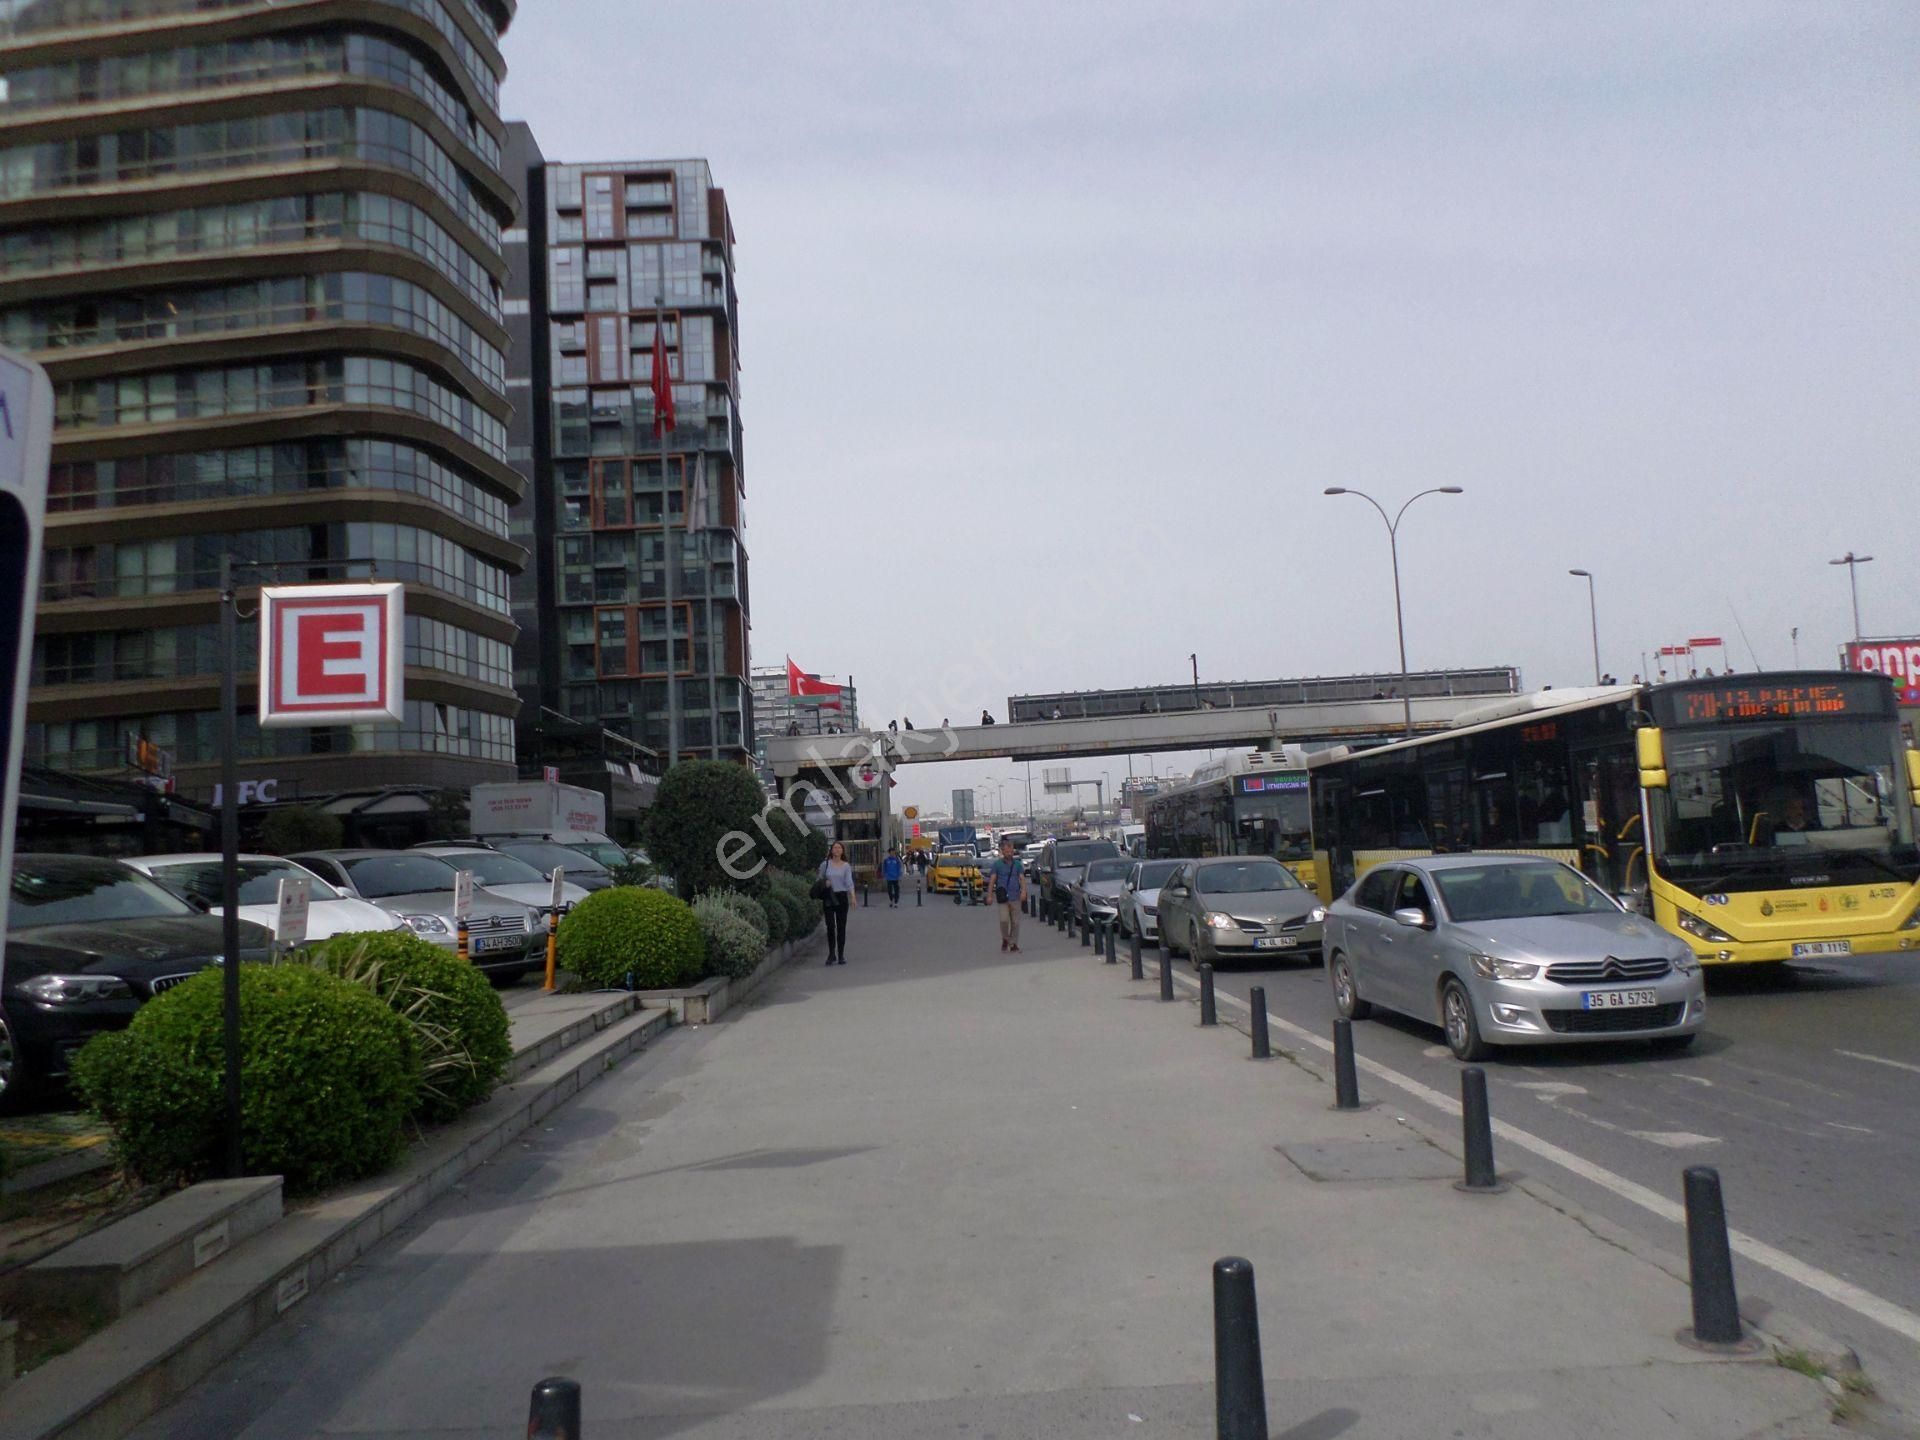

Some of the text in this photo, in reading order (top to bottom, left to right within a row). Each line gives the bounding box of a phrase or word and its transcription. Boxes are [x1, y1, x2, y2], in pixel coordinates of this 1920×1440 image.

[298, 613, 366, 696] E
[1798, 944, 1808, 954] 34
[1590, 991, 1654, 1007] 35 GA 5792
